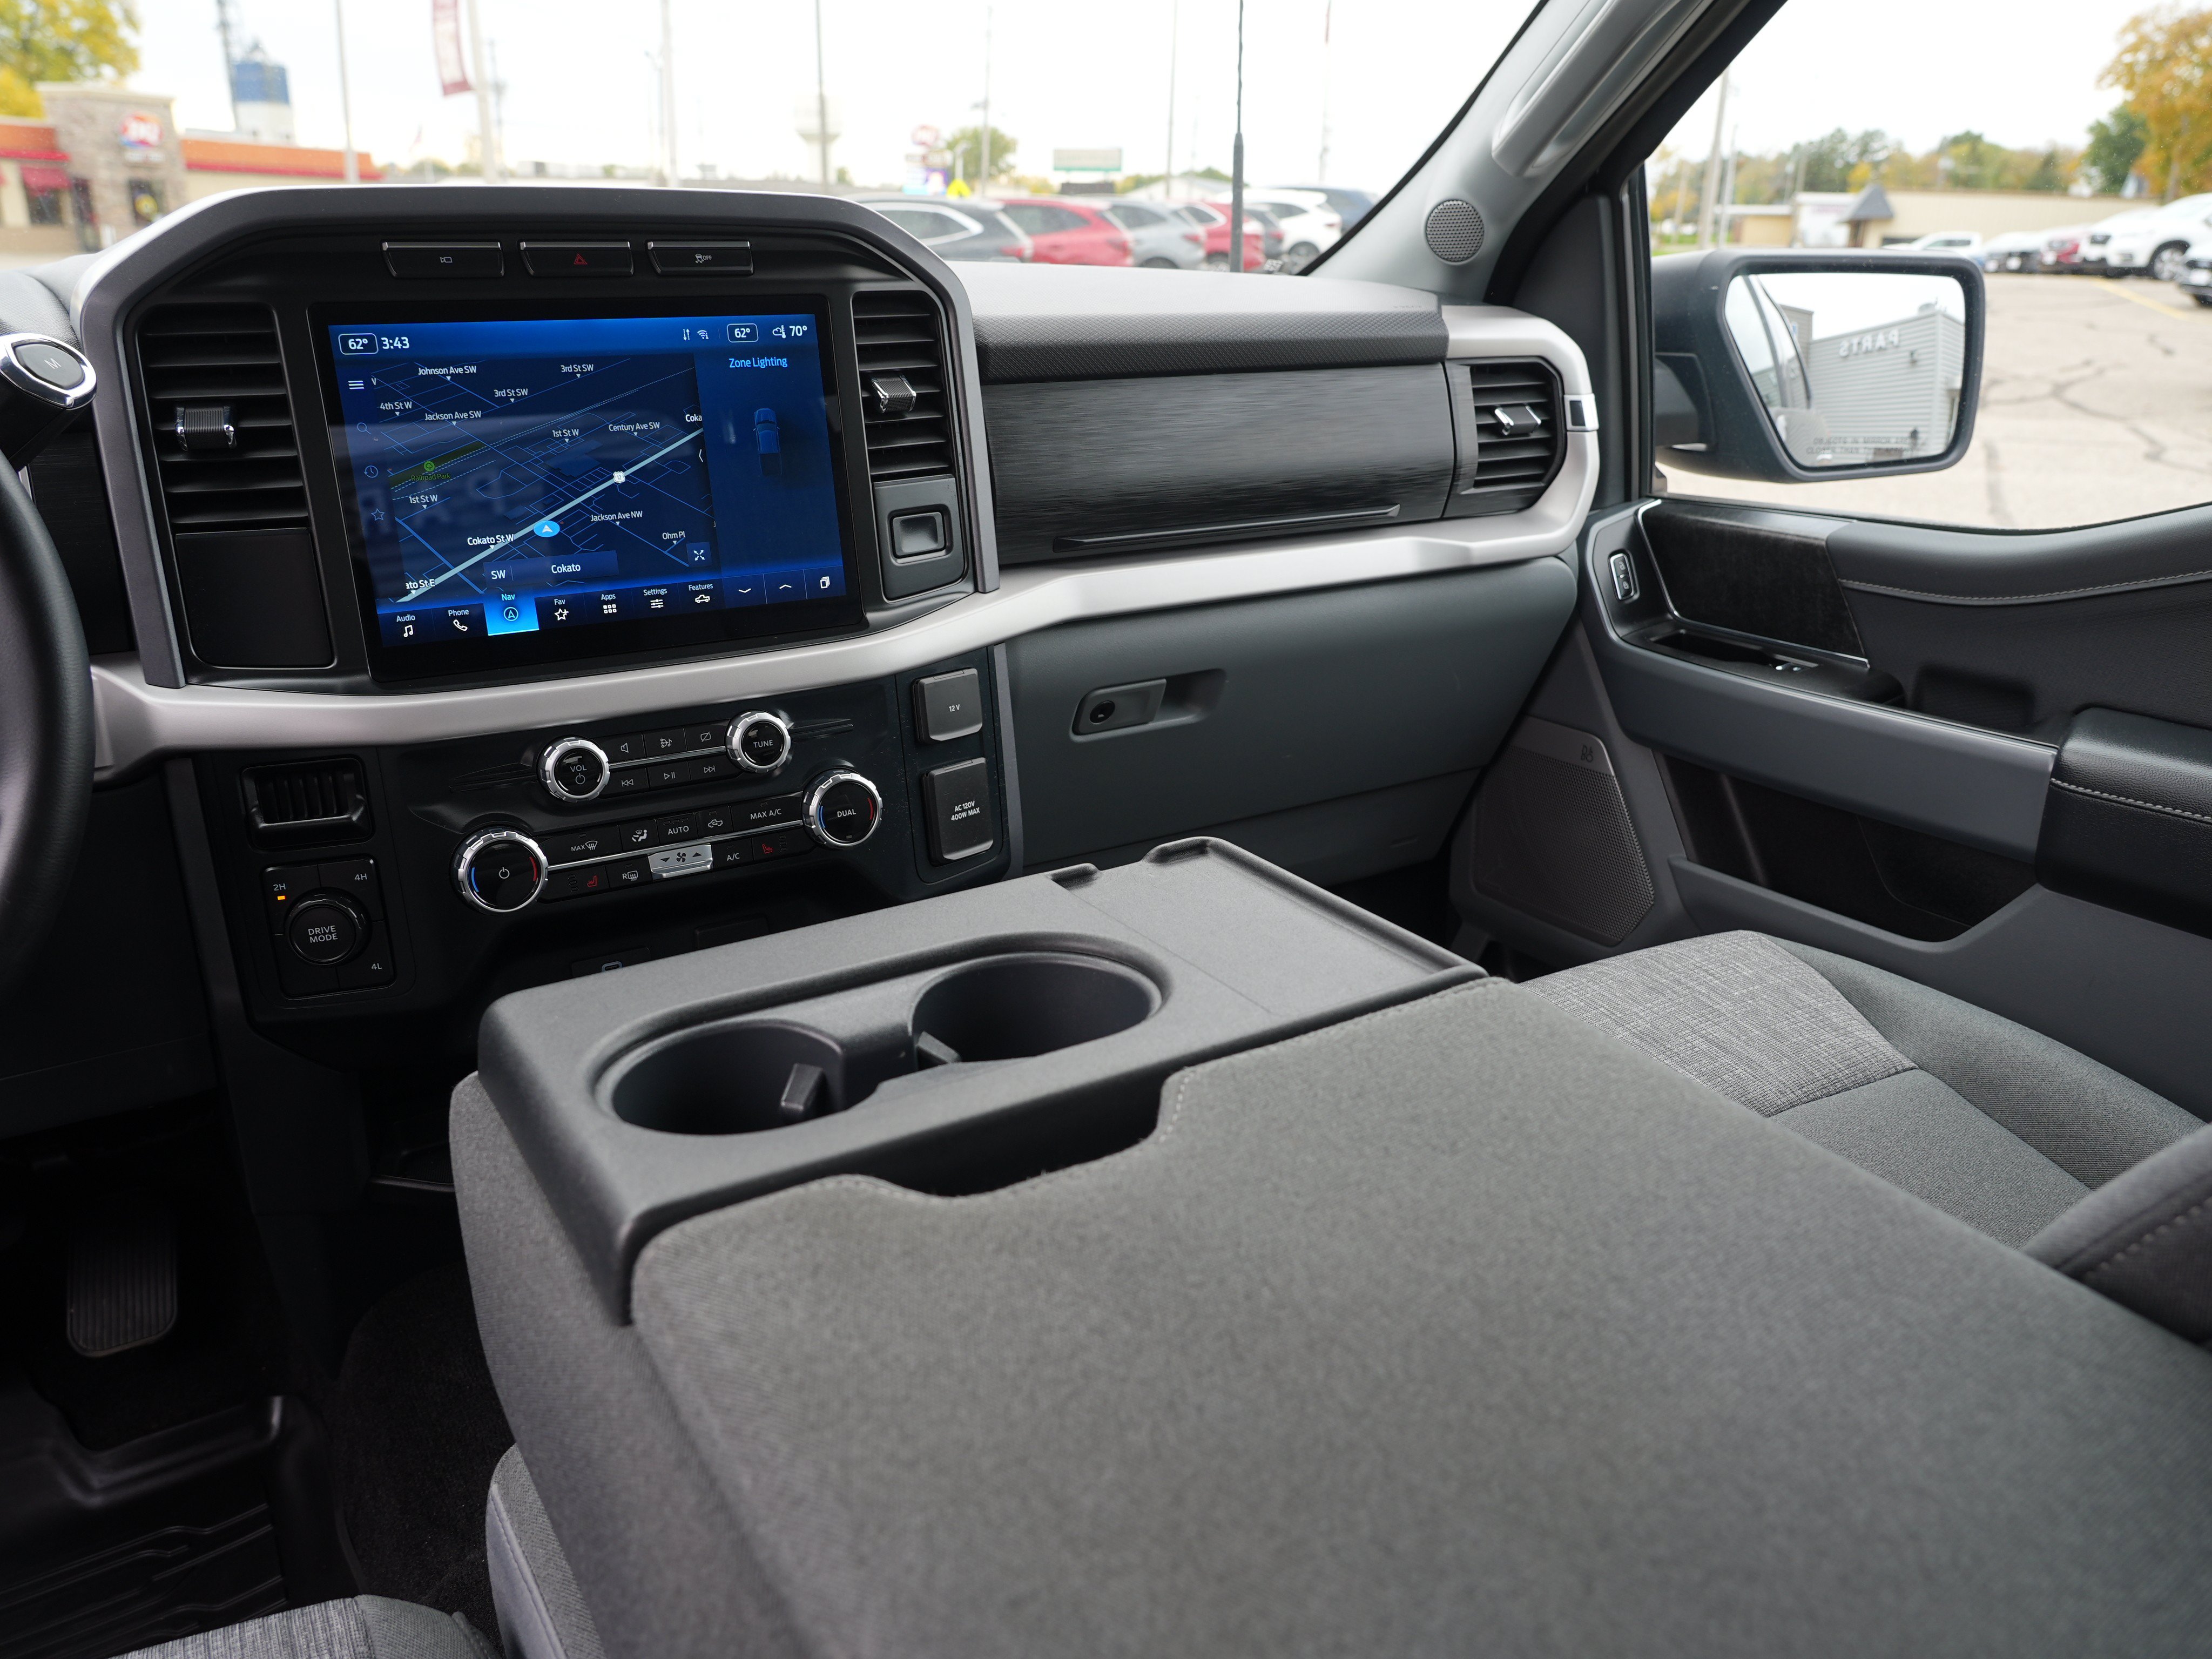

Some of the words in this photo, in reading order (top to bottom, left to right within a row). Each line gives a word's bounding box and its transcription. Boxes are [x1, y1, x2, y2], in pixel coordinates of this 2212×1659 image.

[734, 328, 751, 338] 62°
[789, 325, 807, 336] 70°
[348, 339, 368, 350] 62°
[381, 337, 410, 349] 3:43
[44, 358, 62, 369] M
[729, 358, 751, 368] Zone
[752, 356, 788, 368] Lighting
[418, 367, 449, 375] Johnson
[449, 366, 463, 374] Ave
[464, 366, 476, 374] SW
[380, 402, 394, 410] 4th
[394, 401, 404, 410] St
[403, 401, 412, 409] W
[424, 413, 454, 421] Jackson
[469, 410, 481, 419] SW
[685, 414, 703, 422] Coka
[430, 494, 438, 502] W
[591, 514, 617, 522] Jackson
[467, 536, 495, 545] Cokato
[496, 535, 505, 543] St
[505, 534, 515, 542] W
[662, 532, 678, 540] Ohm
[551, 563, 581, 574] Cokato
[491, 570, 506, 579] SW
[419, 579, 429, 588] St
[429, 578, 436, 587] E
[688, 583, 713, 591] Features
[643, 588, 667, 596] Settings
[448, 609, 469, 617] Phone
[753, 739, 774, 748] TUNE
[570, 765, 588, 773] VOL
[954, 804, 962, 812] AC
[962, 800, 976, 810] 120V
[750, 811, 767, 819] MAX
[768, 808, 783, 817] A/C
[837, 809, 857, 818] DUAL
[950, 811, 967, 821] 400W
[968, 807, 980, 816] MAX
[667, 825, 690, 835] AUTO
[726, 852, 740, 861] A/C
[354, 873, 368, 881] 4H
[273, 883, 287, 891] 2H
[308, 925, 336, 935] DRIVE
[309, 933, 338, 943] MODE
[371, 962, 383, 970] 4L
